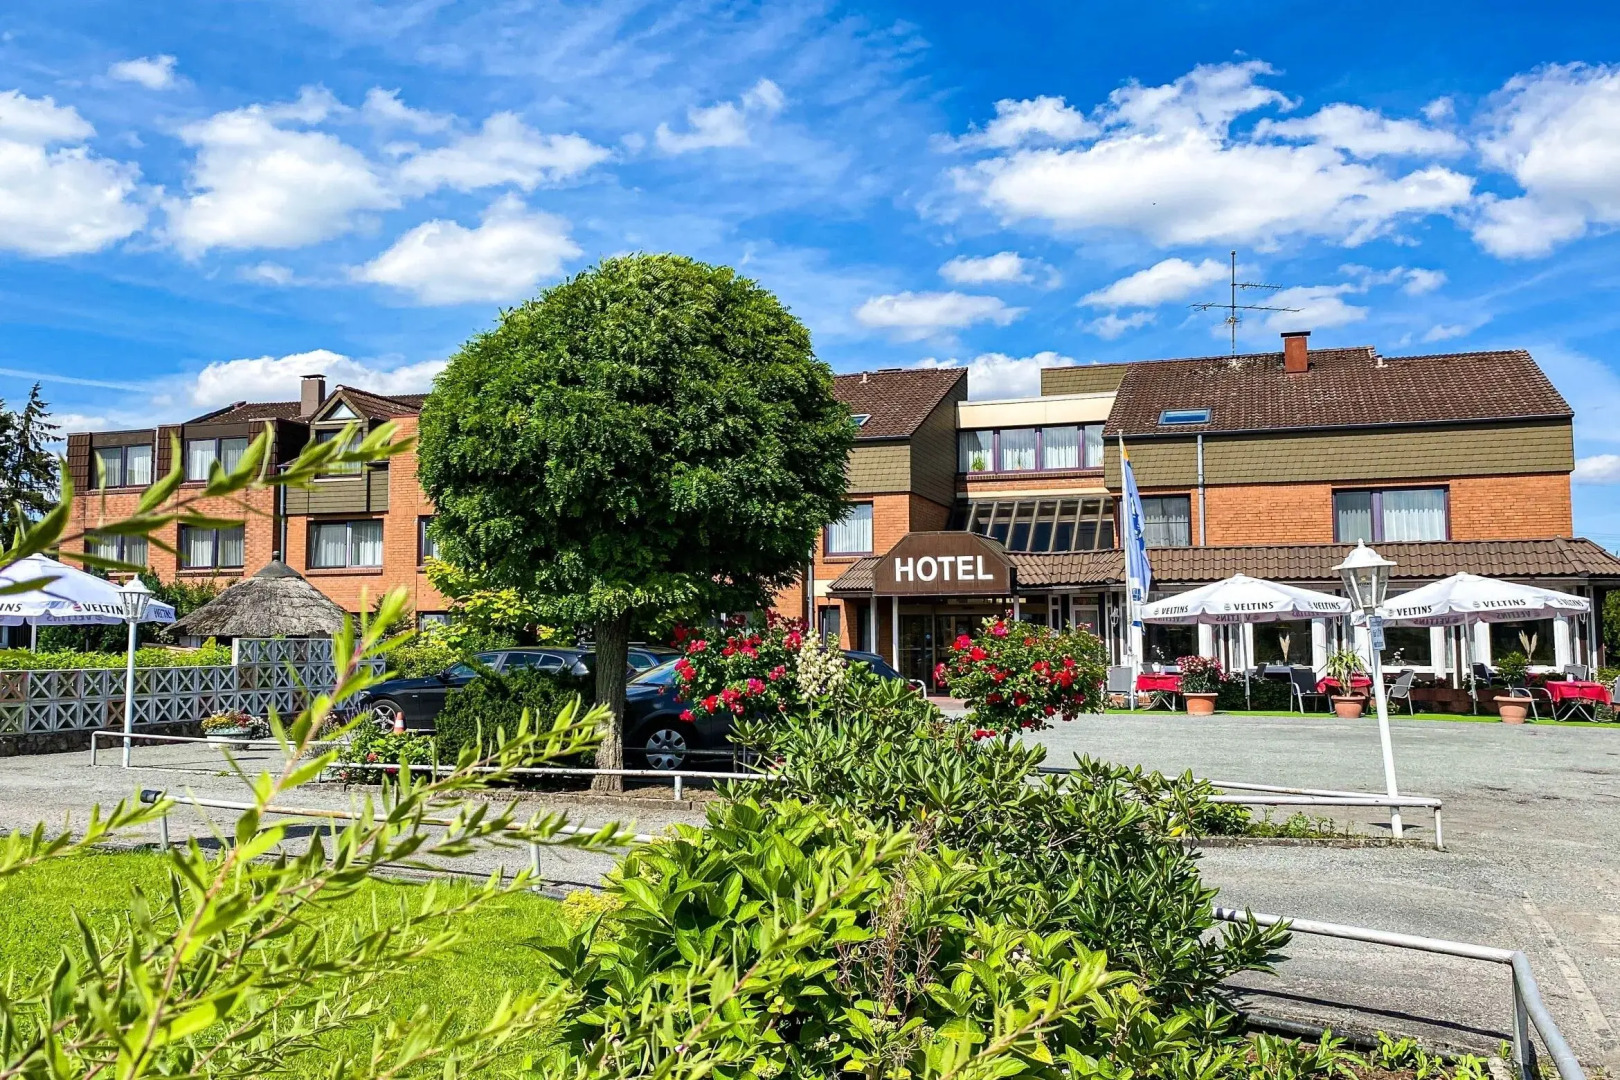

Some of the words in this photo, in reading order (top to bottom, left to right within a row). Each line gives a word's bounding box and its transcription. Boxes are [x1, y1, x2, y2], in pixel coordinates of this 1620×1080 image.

[894, 555, 994, 582] HOTEL
[1233, 601, 1274, 611] VELTINS
[1313, 602, 1341, 610] VELTINS
[1482, 599, 1527, 608] VELTINS
[1161, 605, 1189, 615] VELTINS
[1396, 604, 1433, 616] VELTINS
